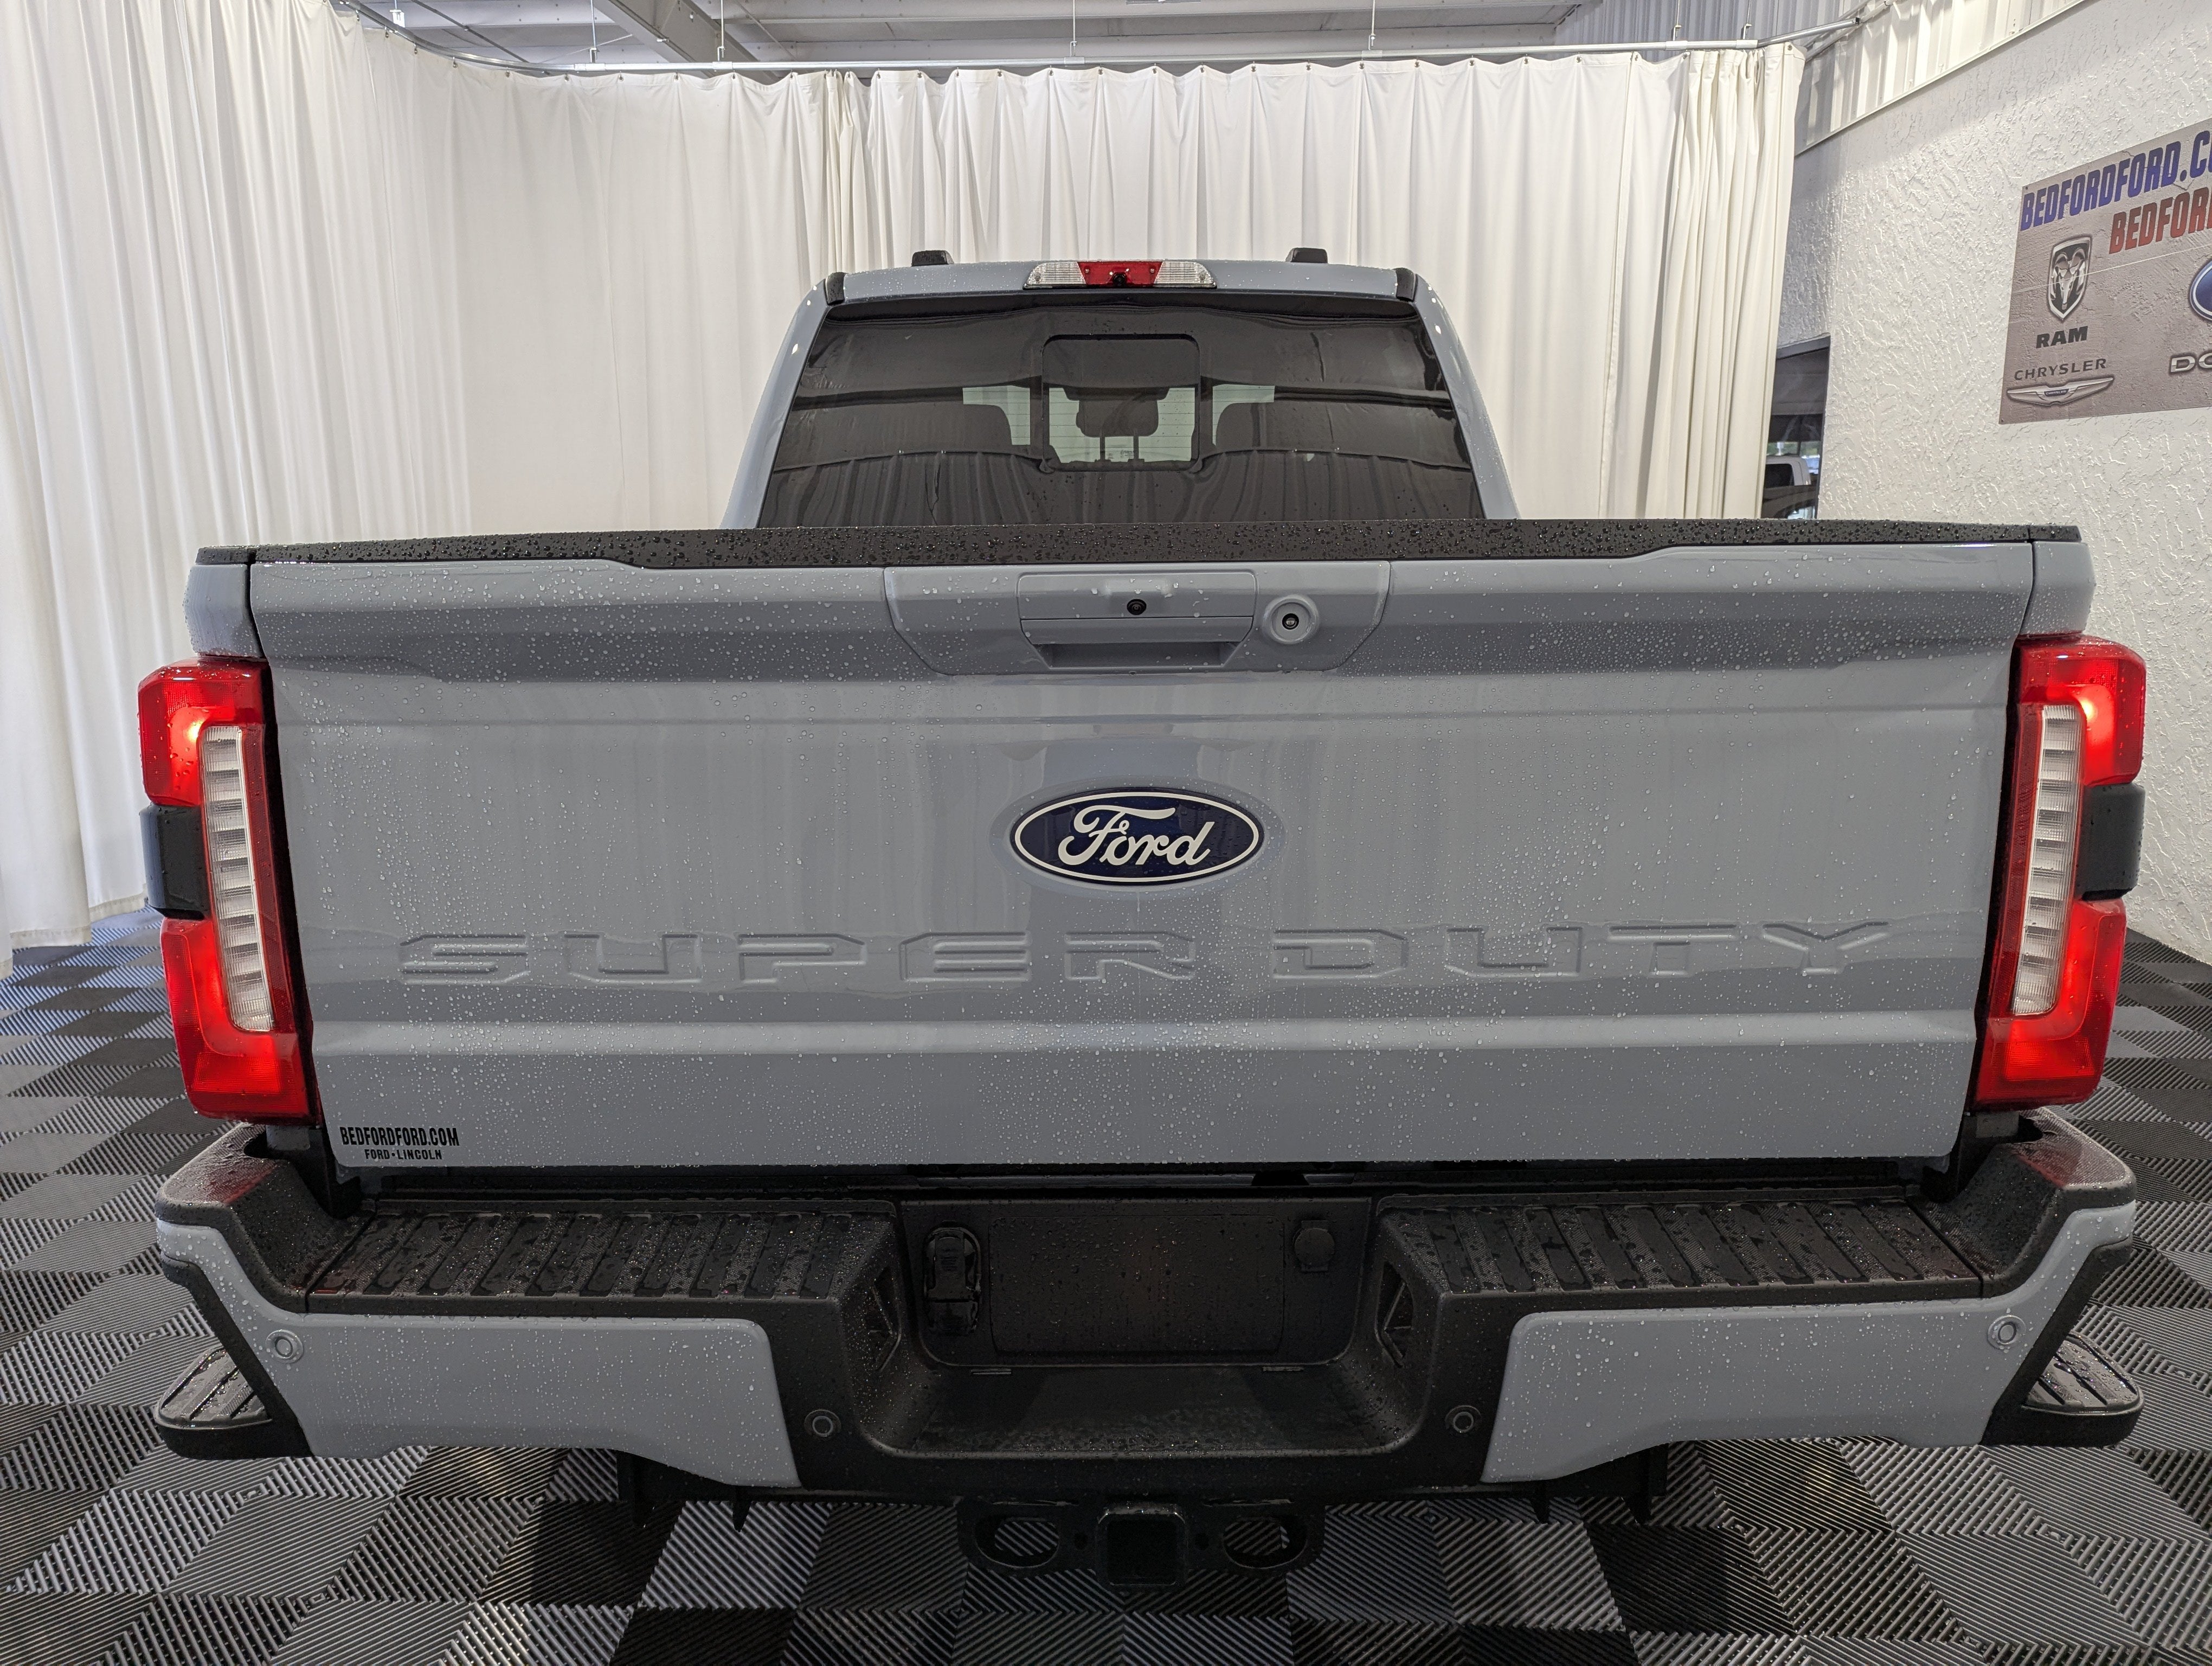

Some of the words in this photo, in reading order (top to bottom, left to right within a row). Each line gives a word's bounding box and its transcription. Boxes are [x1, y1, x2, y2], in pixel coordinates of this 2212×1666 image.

[2020, 129, 2212, 232] BEDFORDFORD.C
[2036, 325, 2088, 349] RAM
[2014, 358, 2107, 381] CHRYSLER
[1058, 805, 1215, 866] Ford
[398, 932, 1195, 985] SUPER
[1271, 921, 1891, 977] DUTY
[339, 1126, 460, 1146] BEDFORDFORD.COM
